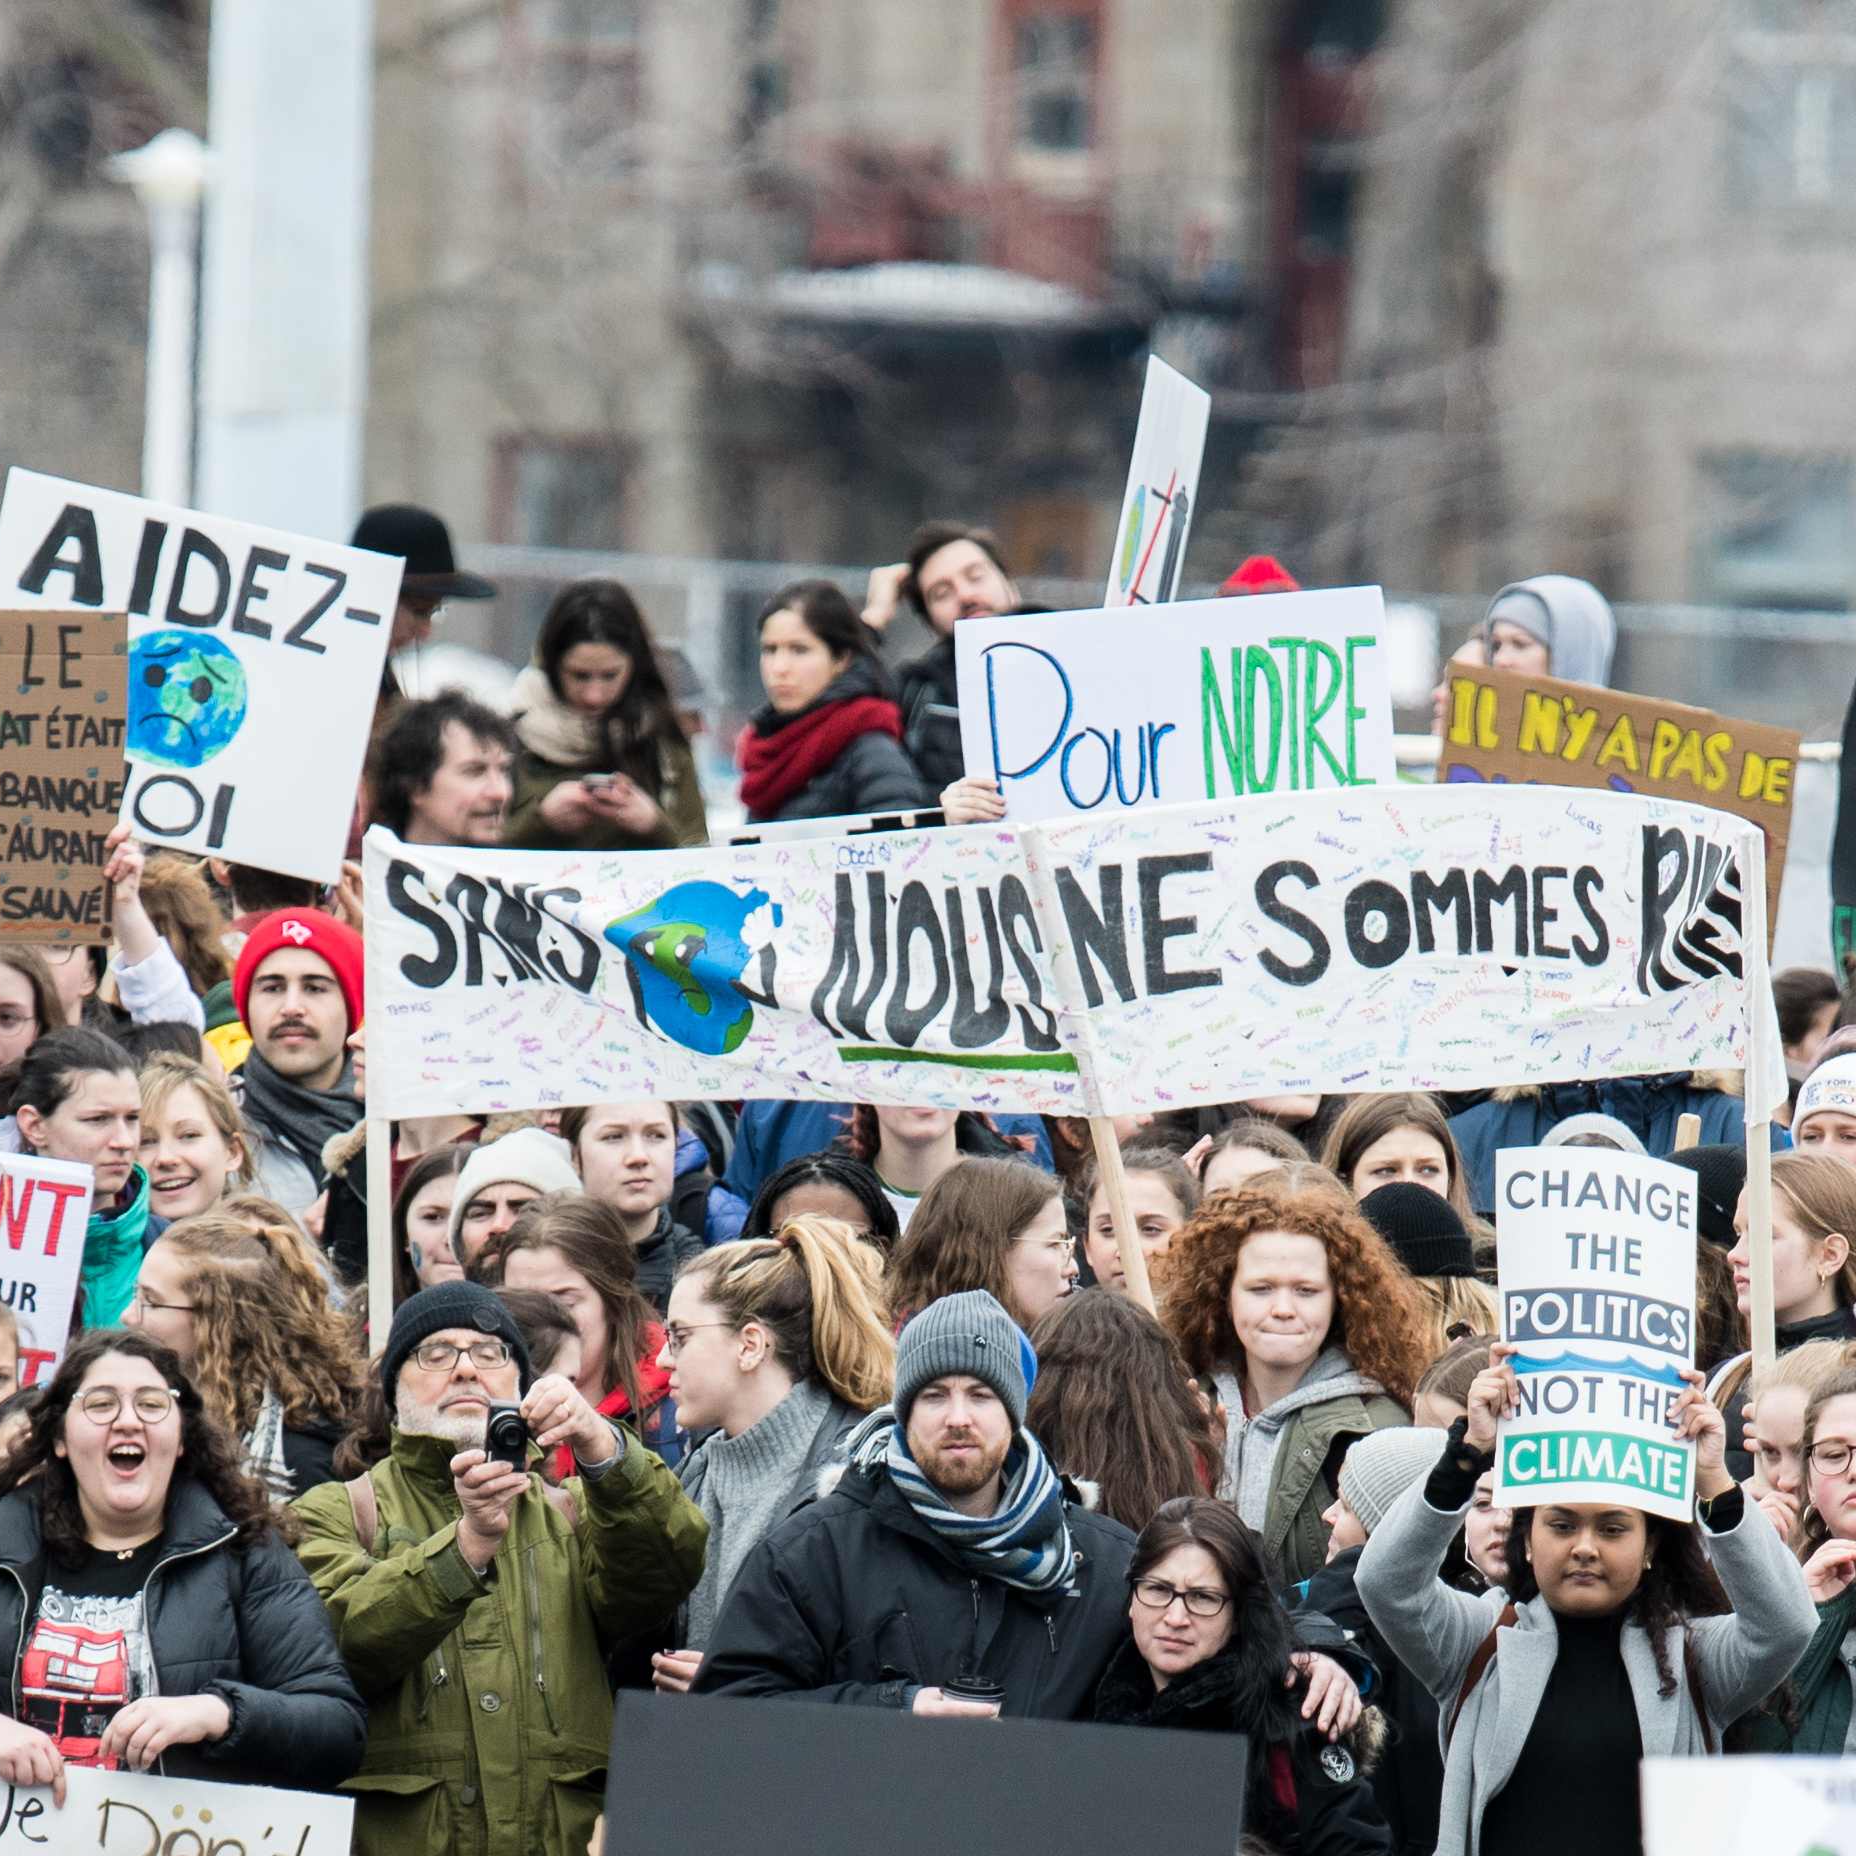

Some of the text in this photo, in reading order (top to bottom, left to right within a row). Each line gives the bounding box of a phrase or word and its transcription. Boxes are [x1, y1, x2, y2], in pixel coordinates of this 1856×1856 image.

[18, 503, 382, 655] AIDEZ-
[22, 624, 83, 688] LE
[46, 707, 127, 749] ÉTAIT
[980, 635, 1377, 810] Pour NOTRE
[1447, 677, 1500, 750] IL
[1518, 688, 1600, 762] N'Y
[1596, 713, 1640, 772] A
[1647, 718, 1734, 792] PAS
[1739, 749, 1794, 803] DE
[124, 764, 235, 849] OI
[1565, 801, 1603, 836] Lucas
[385, 858, 601, 995] SANS
[811, 870, 1063, 1052] NOUS
[1054, 850, 1224, 1009] NE
[1253, 860, 1611, 986] SOMMES
[1505, 1169, 1690, 1230] CHANGE
[1565, 1232, 1643, 1277] THE
[1509, 1291, 1688, 1353] POLITICS
[1515, 1374, 1682, 1430] NOT THE
[1508, 1435, 1684, 1498] CLIMATE
